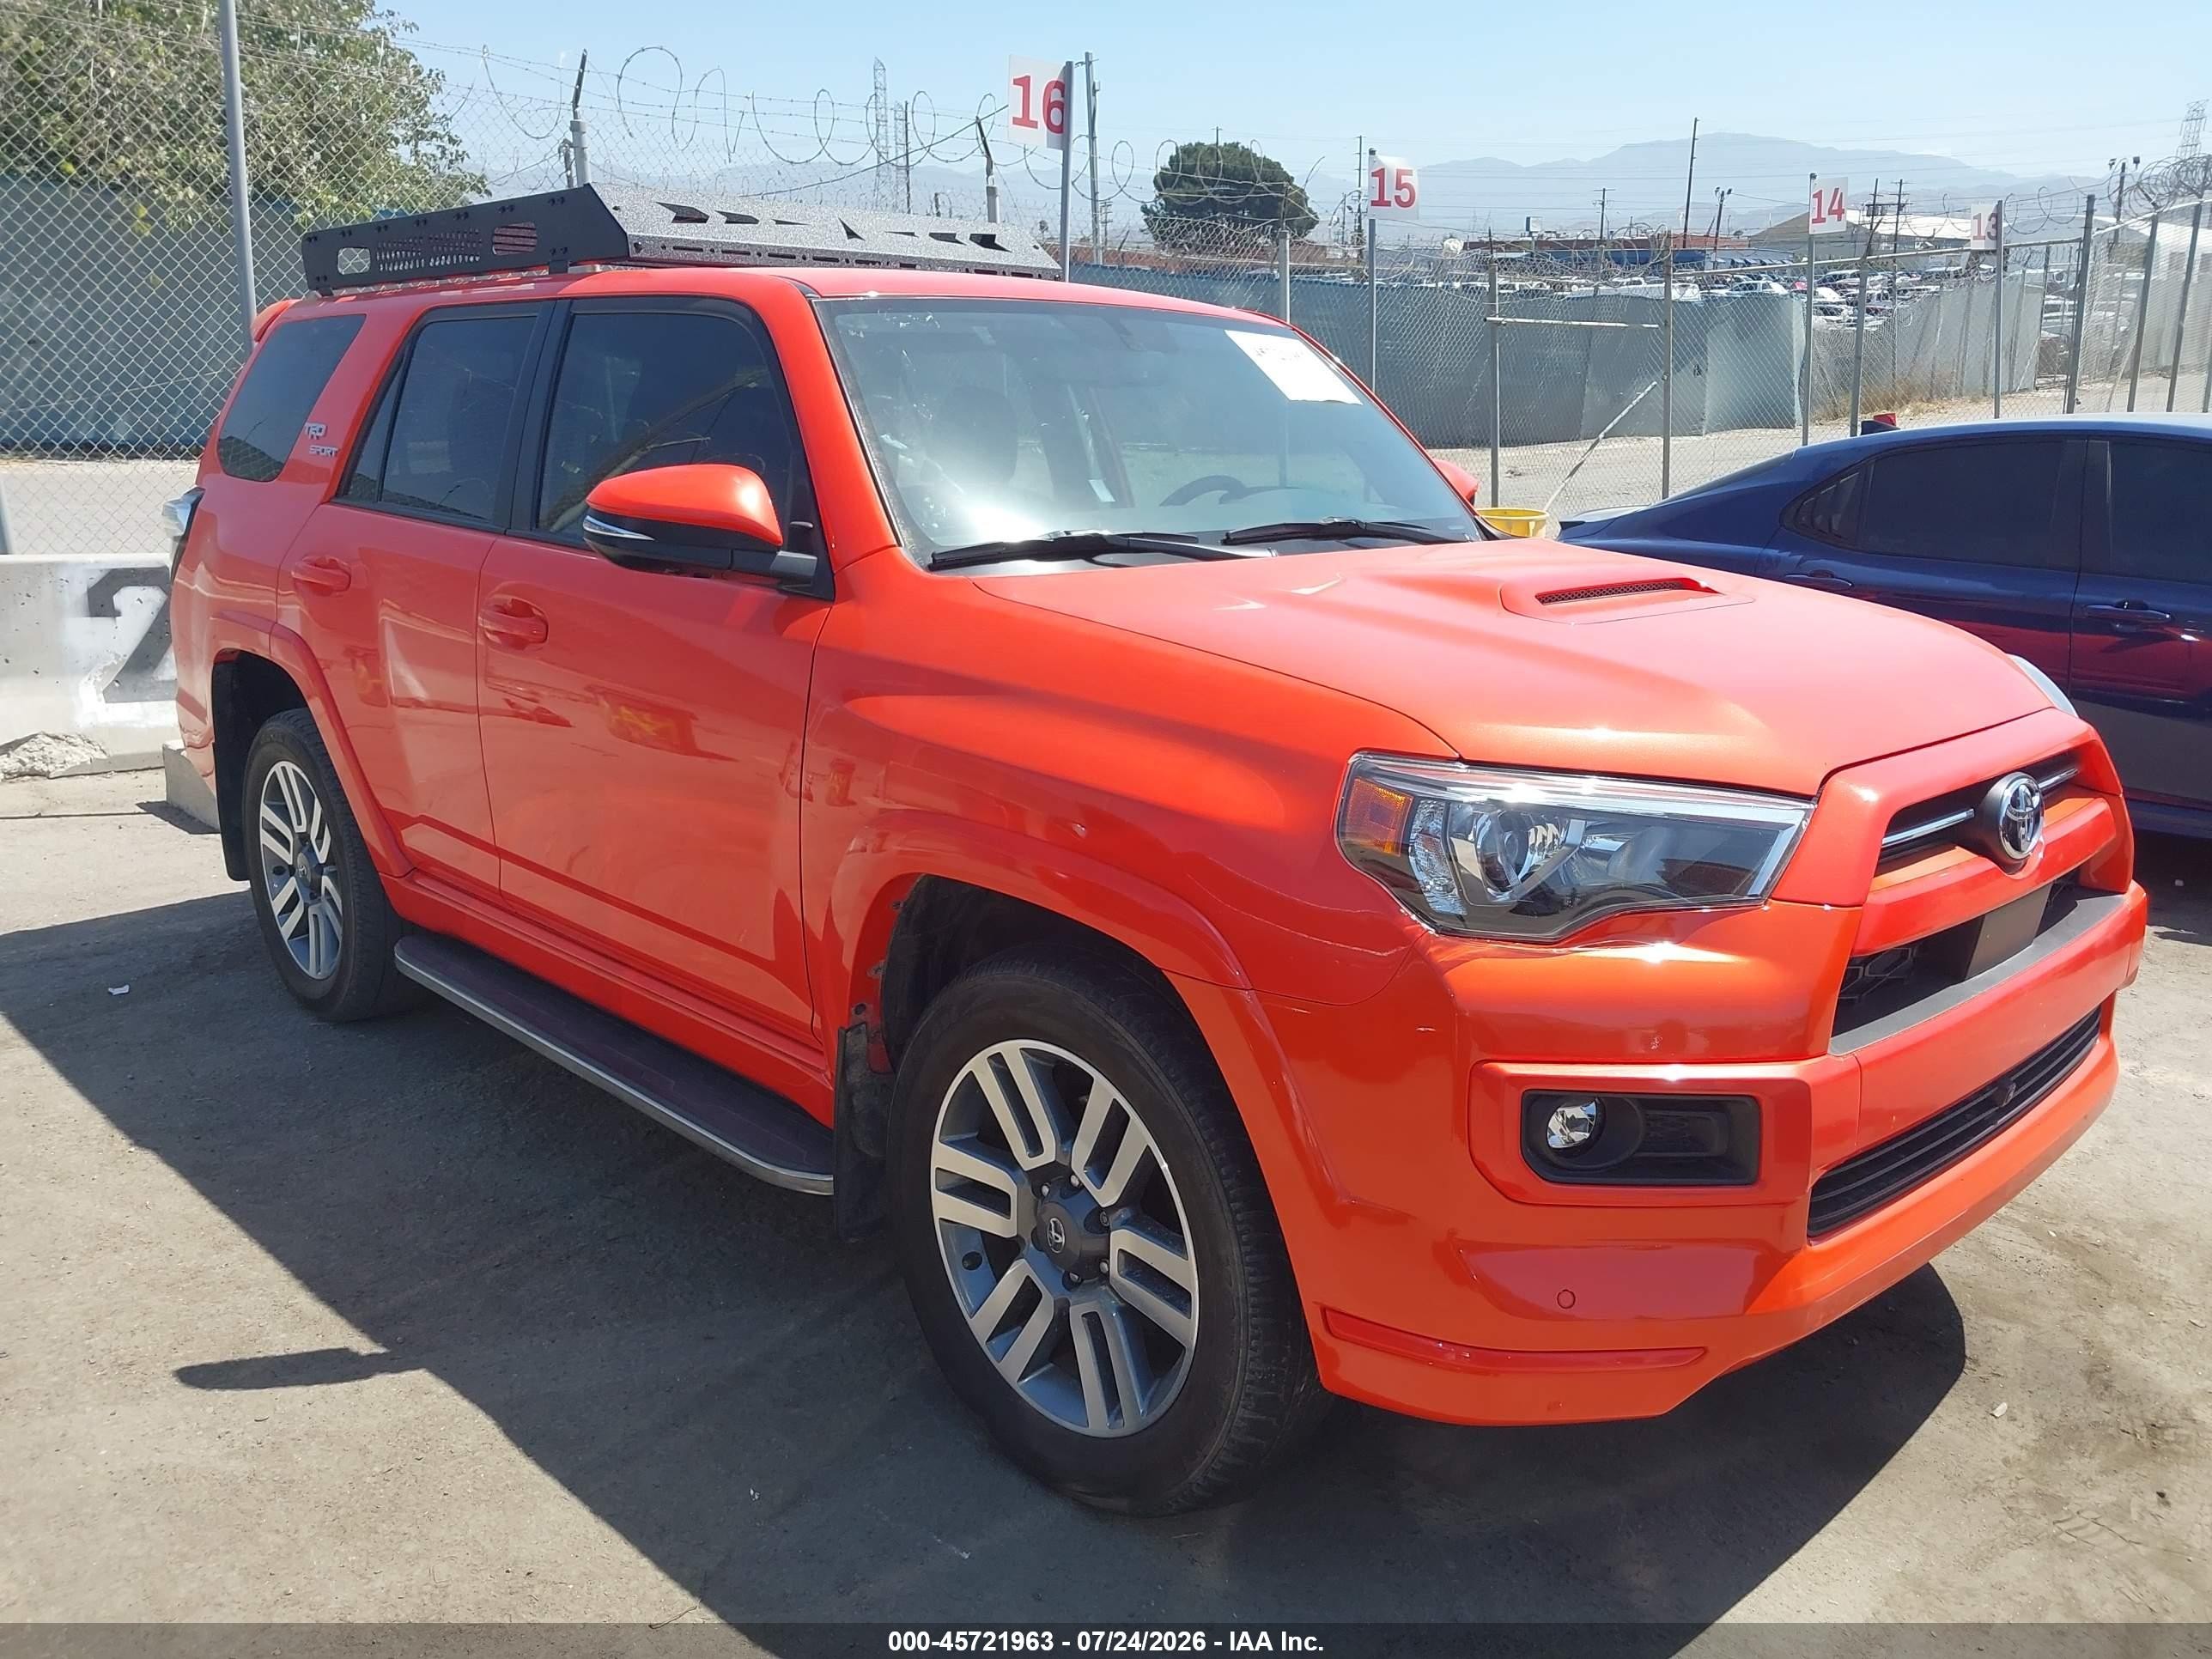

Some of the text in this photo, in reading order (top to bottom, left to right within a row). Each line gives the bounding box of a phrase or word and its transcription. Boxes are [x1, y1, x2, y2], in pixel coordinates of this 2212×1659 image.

[1012, 75, 1066, 135] 16
[1370, 167, 1417, 209] 15
[1811, 187, 1845, 224] 14
[1972, 212, 1998, 241] 13
[304, 422, 327, 440] TRD
[309, 444, 338, 458] SPORT
[87, 567, 177, 704] 2
